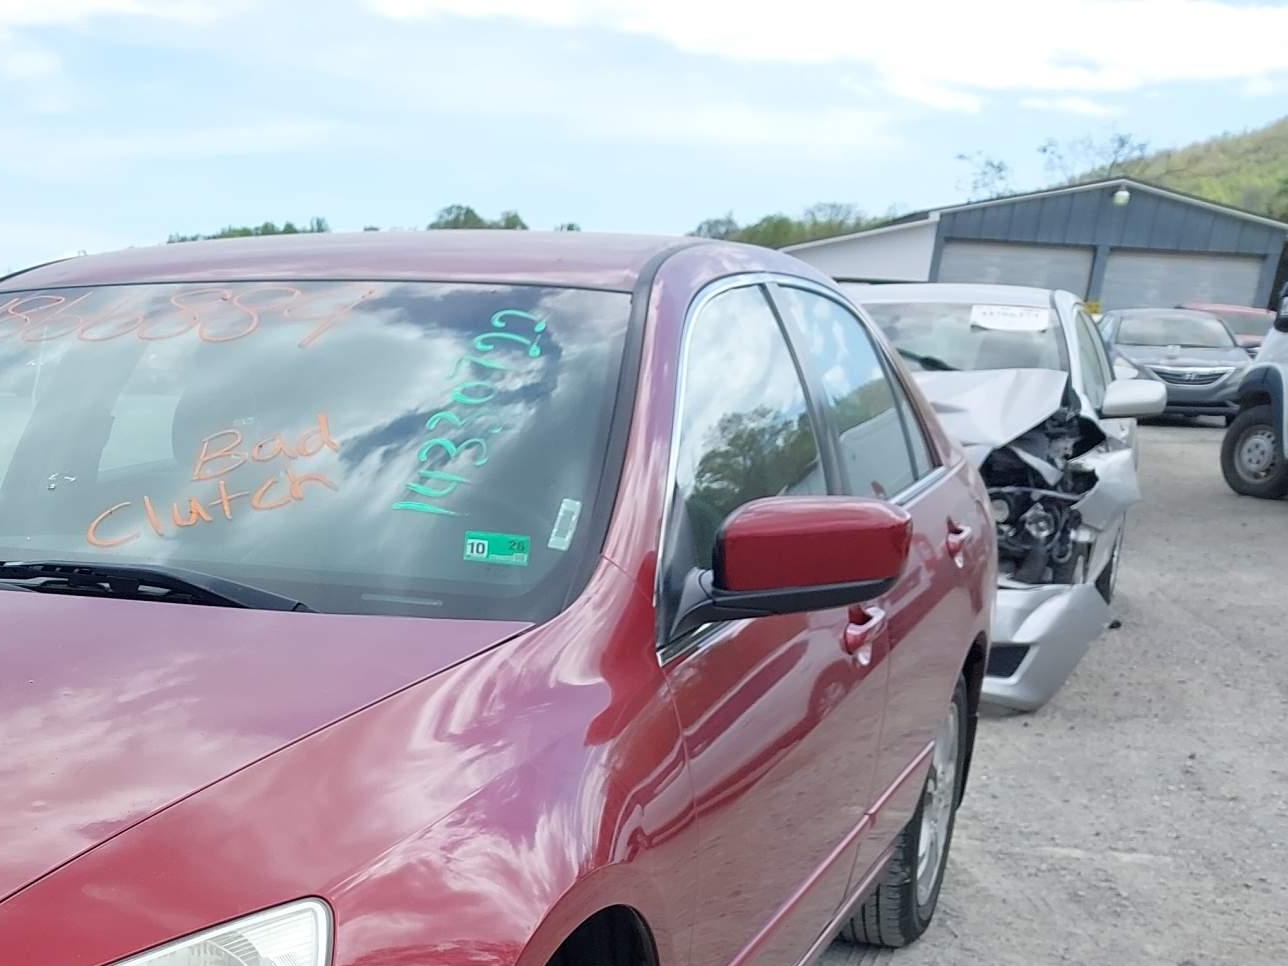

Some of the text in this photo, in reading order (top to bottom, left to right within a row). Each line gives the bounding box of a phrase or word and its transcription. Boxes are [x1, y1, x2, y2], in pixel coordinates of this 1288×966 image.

[191, 411, 339, 482] Bad
[86, 469, 339, 548] Clutch
[468, 541, 486, 555] 10
